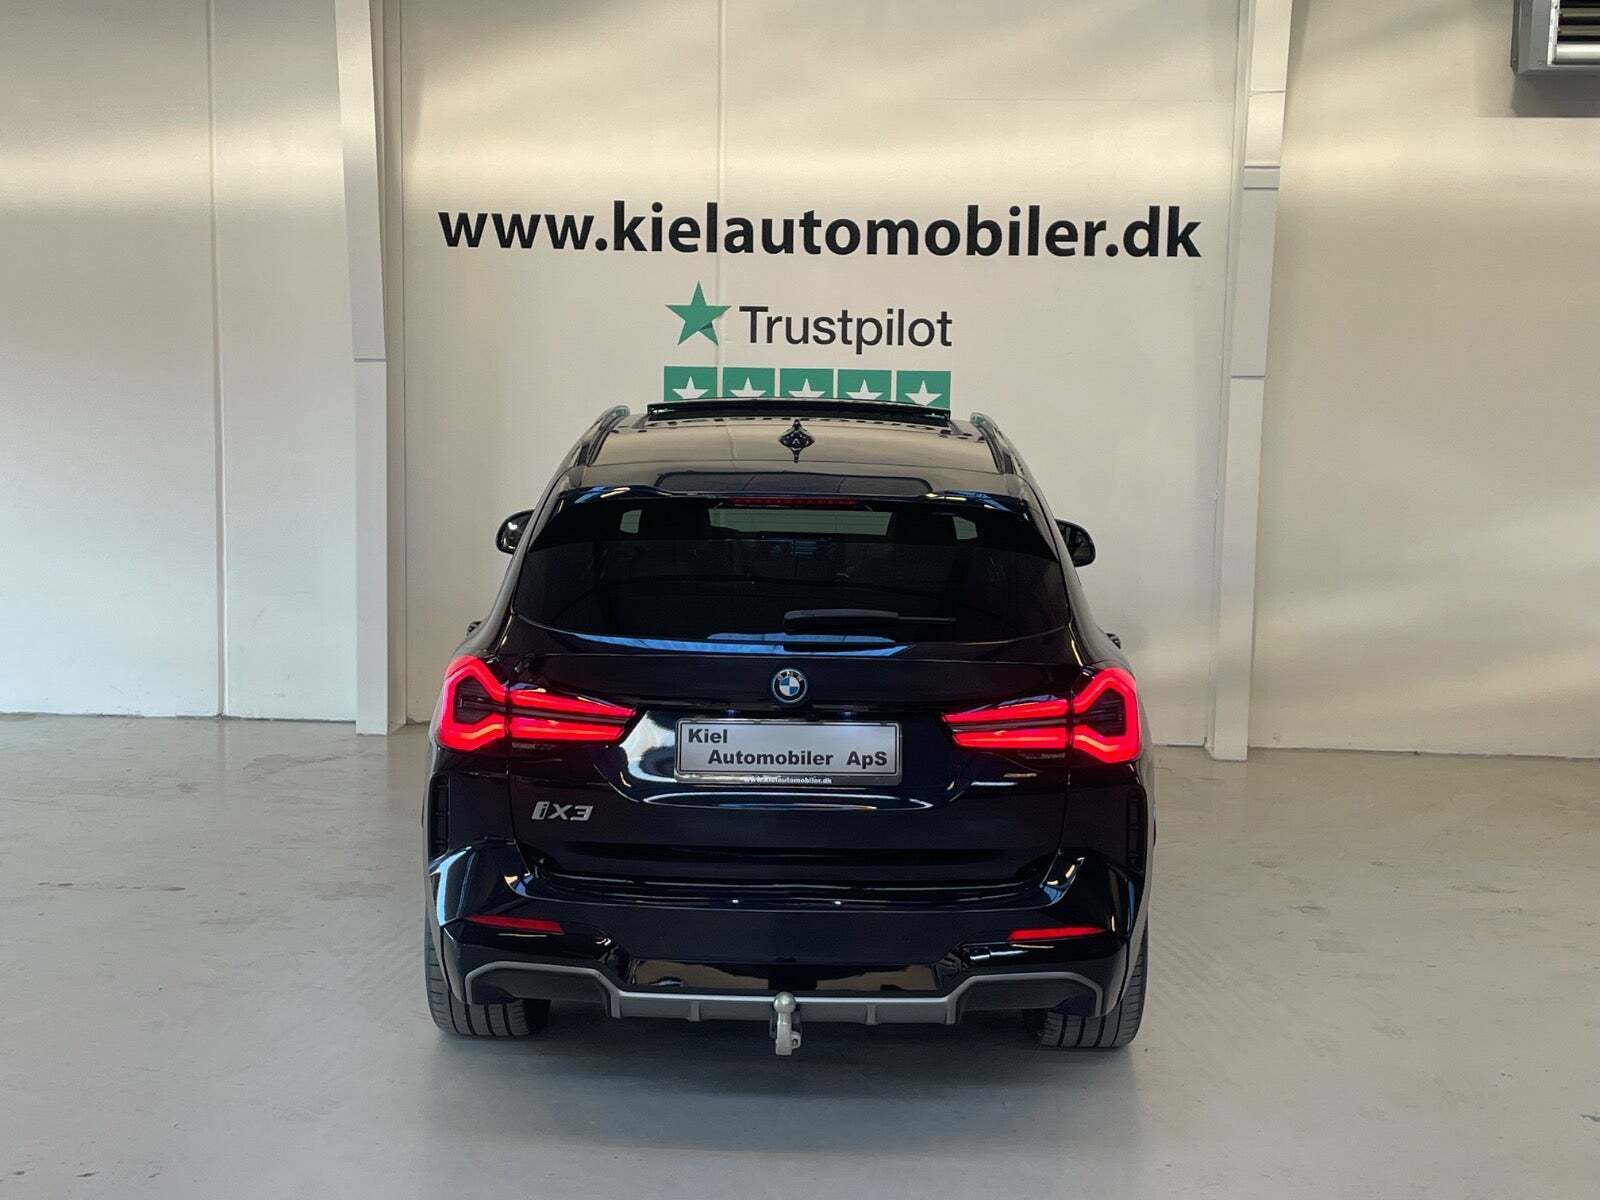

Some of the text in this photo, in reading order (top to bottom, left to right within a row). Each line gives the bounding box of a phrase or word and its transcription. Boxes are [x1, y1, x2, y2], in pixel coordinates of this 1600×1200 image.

[438, 201, 1203, 258] www.kielautomobiler.dk
[738, 305, 953, 355] Trustpilot
[687, 728, 728, 744] Kiel
[708, 749, 887, 769] Automobiler ApS
